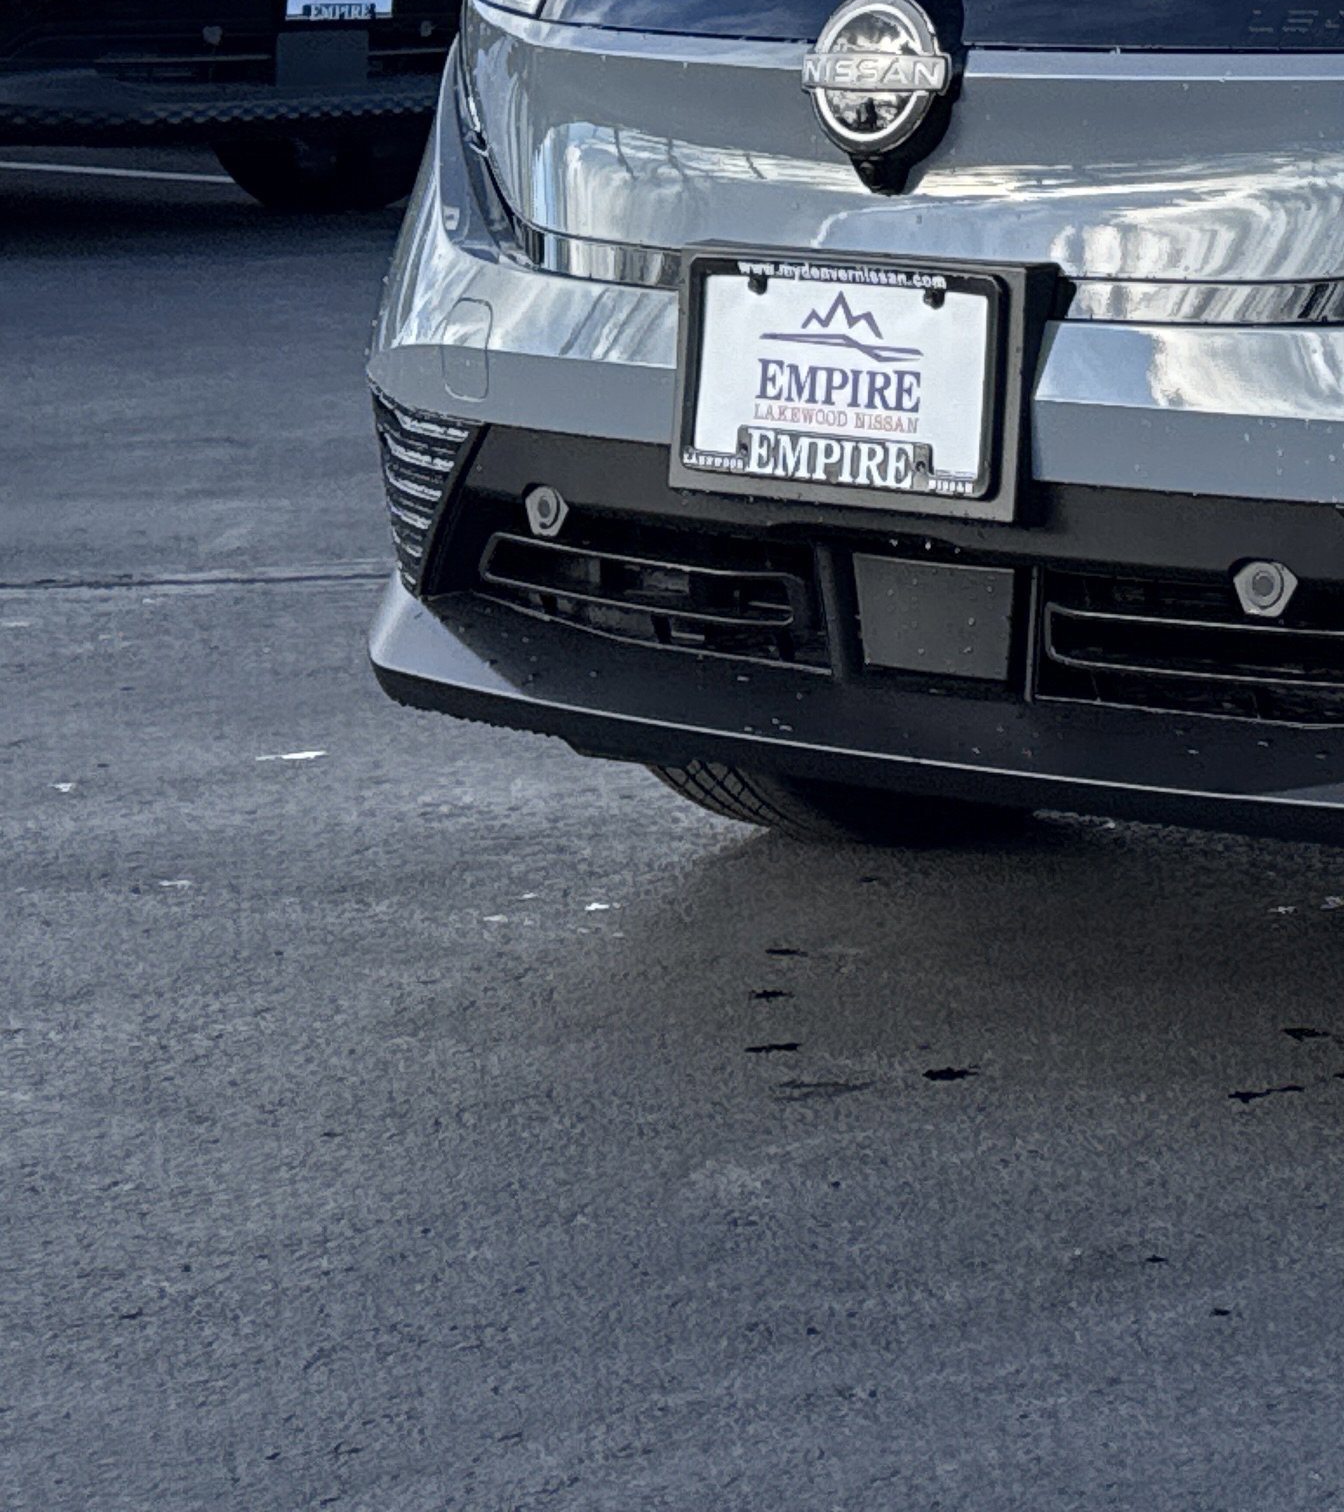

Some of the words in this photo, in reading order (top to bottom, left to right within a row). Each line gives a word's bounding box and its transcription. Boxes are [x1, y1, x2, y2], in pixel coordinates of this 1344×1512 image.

[310, 3, 372, 20] EMPIRE
[804, 58, 940, 85] NISSAN
[755, 358, 921, 414] EMPIRE
[753, 403, 848, 428] LAKEWOOD
[854, 407, 919, 434] NISSAN
[745, 427, 914, 490] EMPIRE
